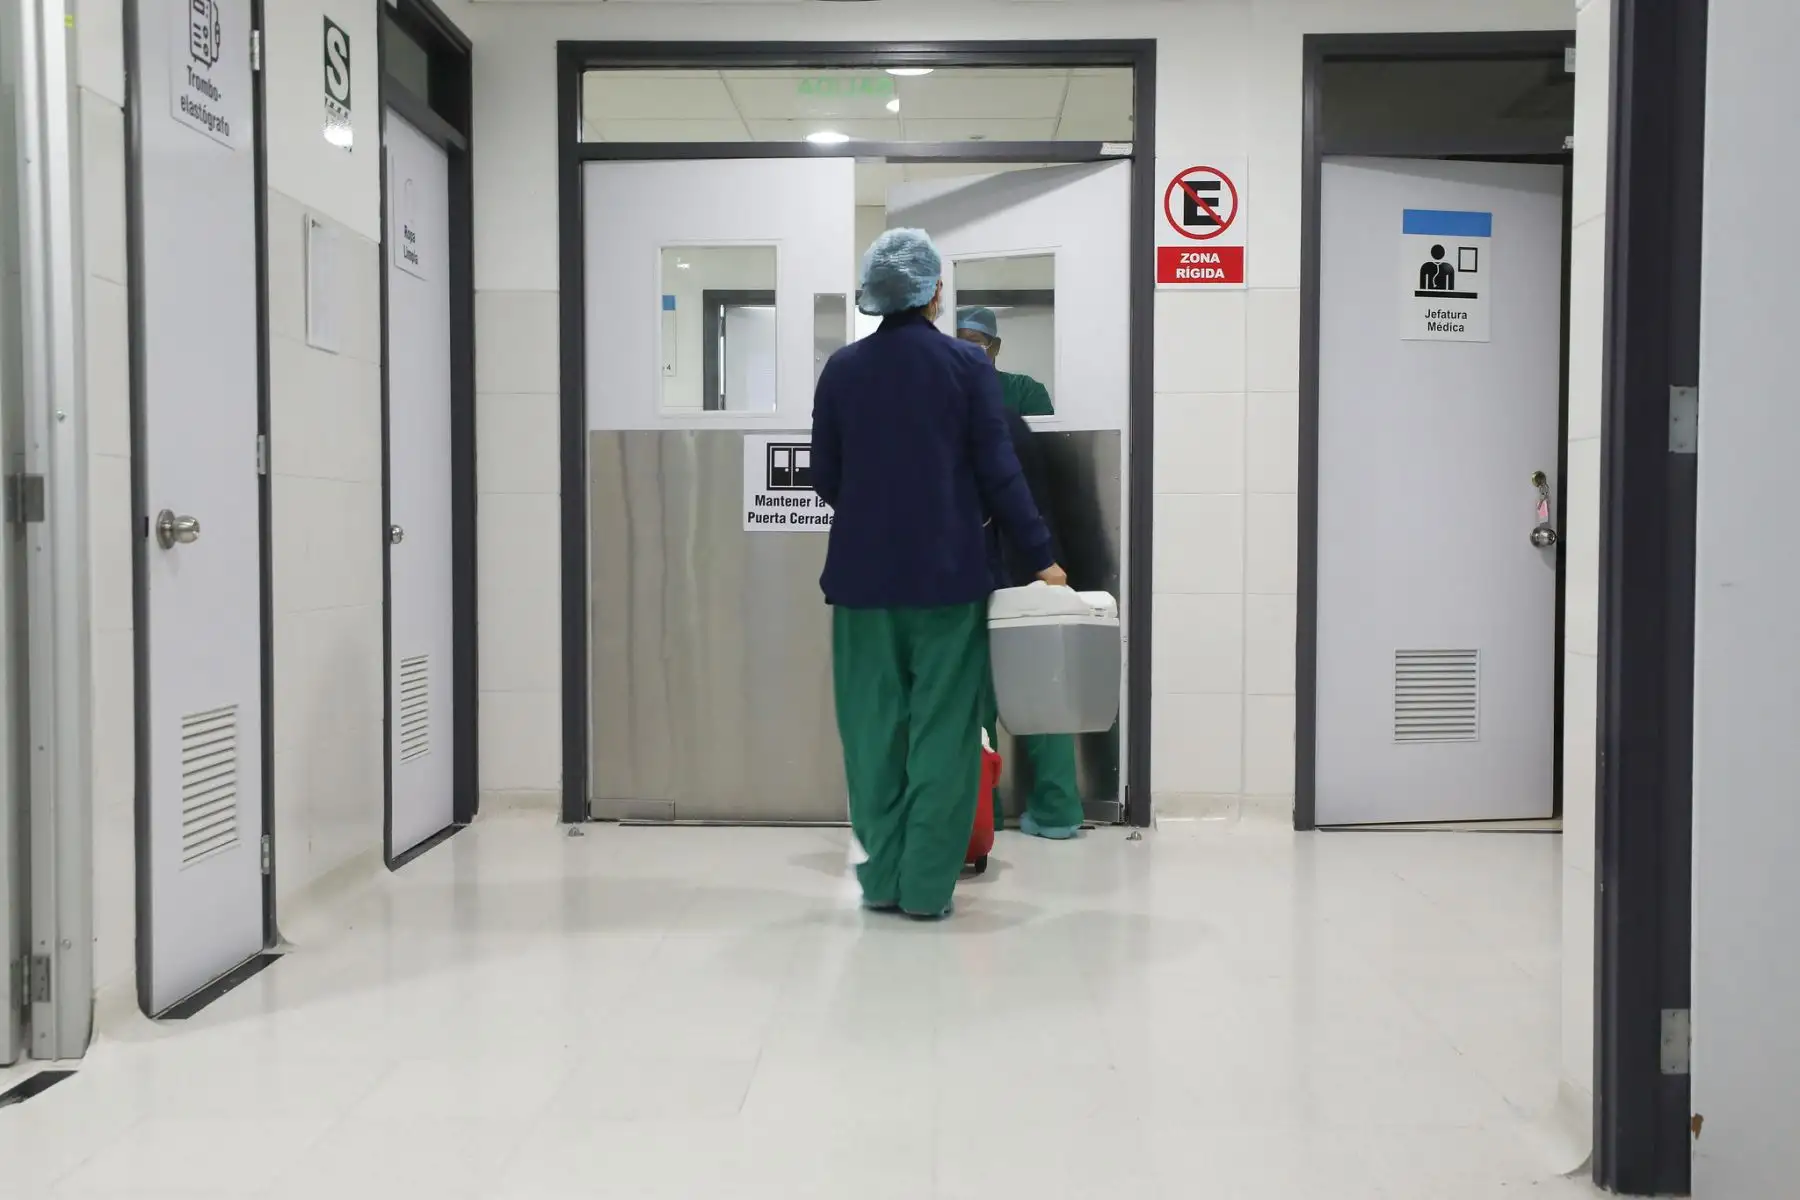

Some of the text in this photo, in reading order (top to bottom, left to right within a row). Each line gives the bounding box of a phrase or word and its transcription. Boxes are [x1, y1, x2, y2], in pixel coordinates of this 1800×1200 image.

[326, 26, 348, 101] S
[187, 64, 221, 102] Trombo-
[180, 94, 230, 136] elastógrafo
[1183, 181, 1221, 226] E
[1180, 253, 1221, 264] ZONA
[1176, 266, 1225, 279] RÍGIDA
[1425, 309, 1467, 320] Jefatura
[1428, 321, 1464, 332] Médica
[755, 494, 826, 508] Mantener la
[747, 511, 835, 525] Puerta Cerrada
